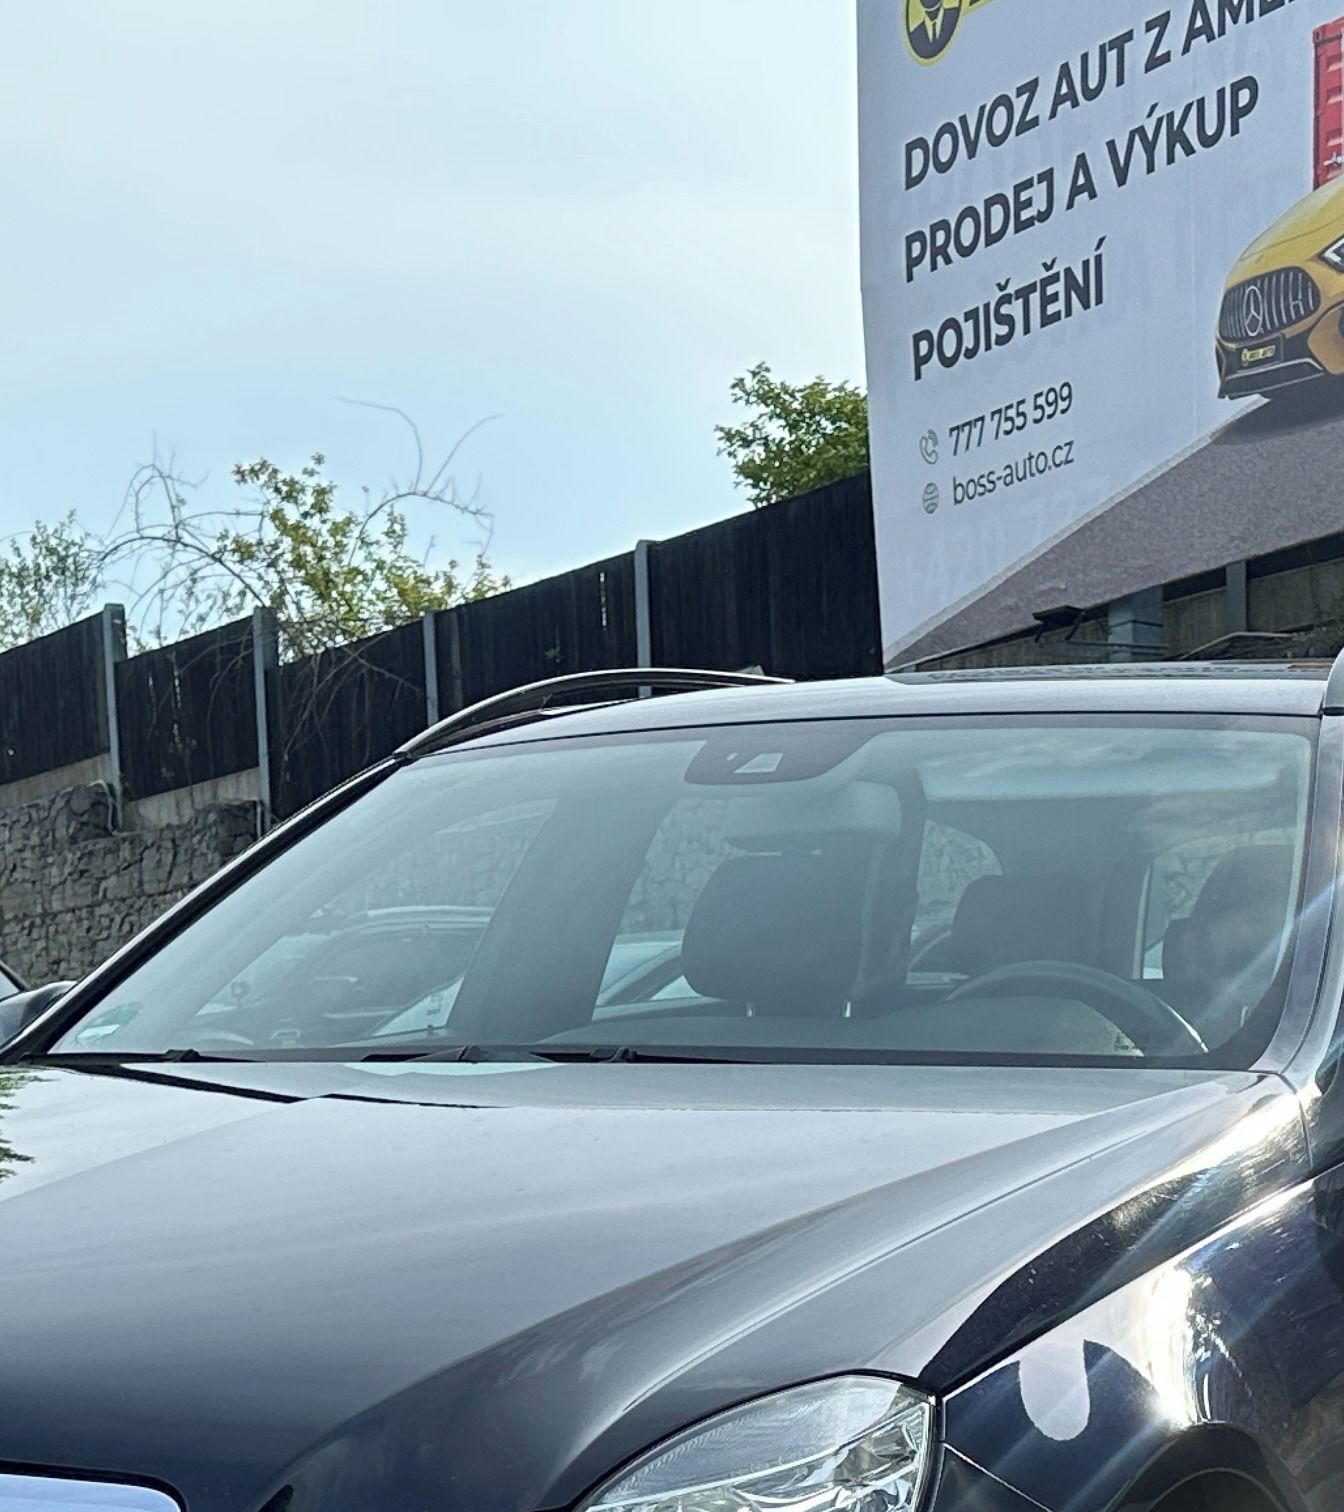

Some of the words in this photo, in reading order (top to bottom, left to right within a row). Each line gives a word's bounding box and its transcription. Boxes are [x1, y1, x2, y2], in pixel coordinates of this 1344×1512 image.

[905, 76, 1039, 191] DOVOZ
[1048, 28, 1134, 121] AUT
[1144, 9, 1171, 74] Z
[905, 167, 1054, 284] PRODEJ
[1066, 152, 1098, 211] A
[1105, 75, 1259, 188] VÝKUP
[912, 235, 1107, 382] POJIŠTĚNÍ
[948, 415, 986, 456] 777
[990, 398, 1027, 441] 755
[1032, 381, 1073, 424] 599
[953, 440, 1075, 506] boss-auto.cz
